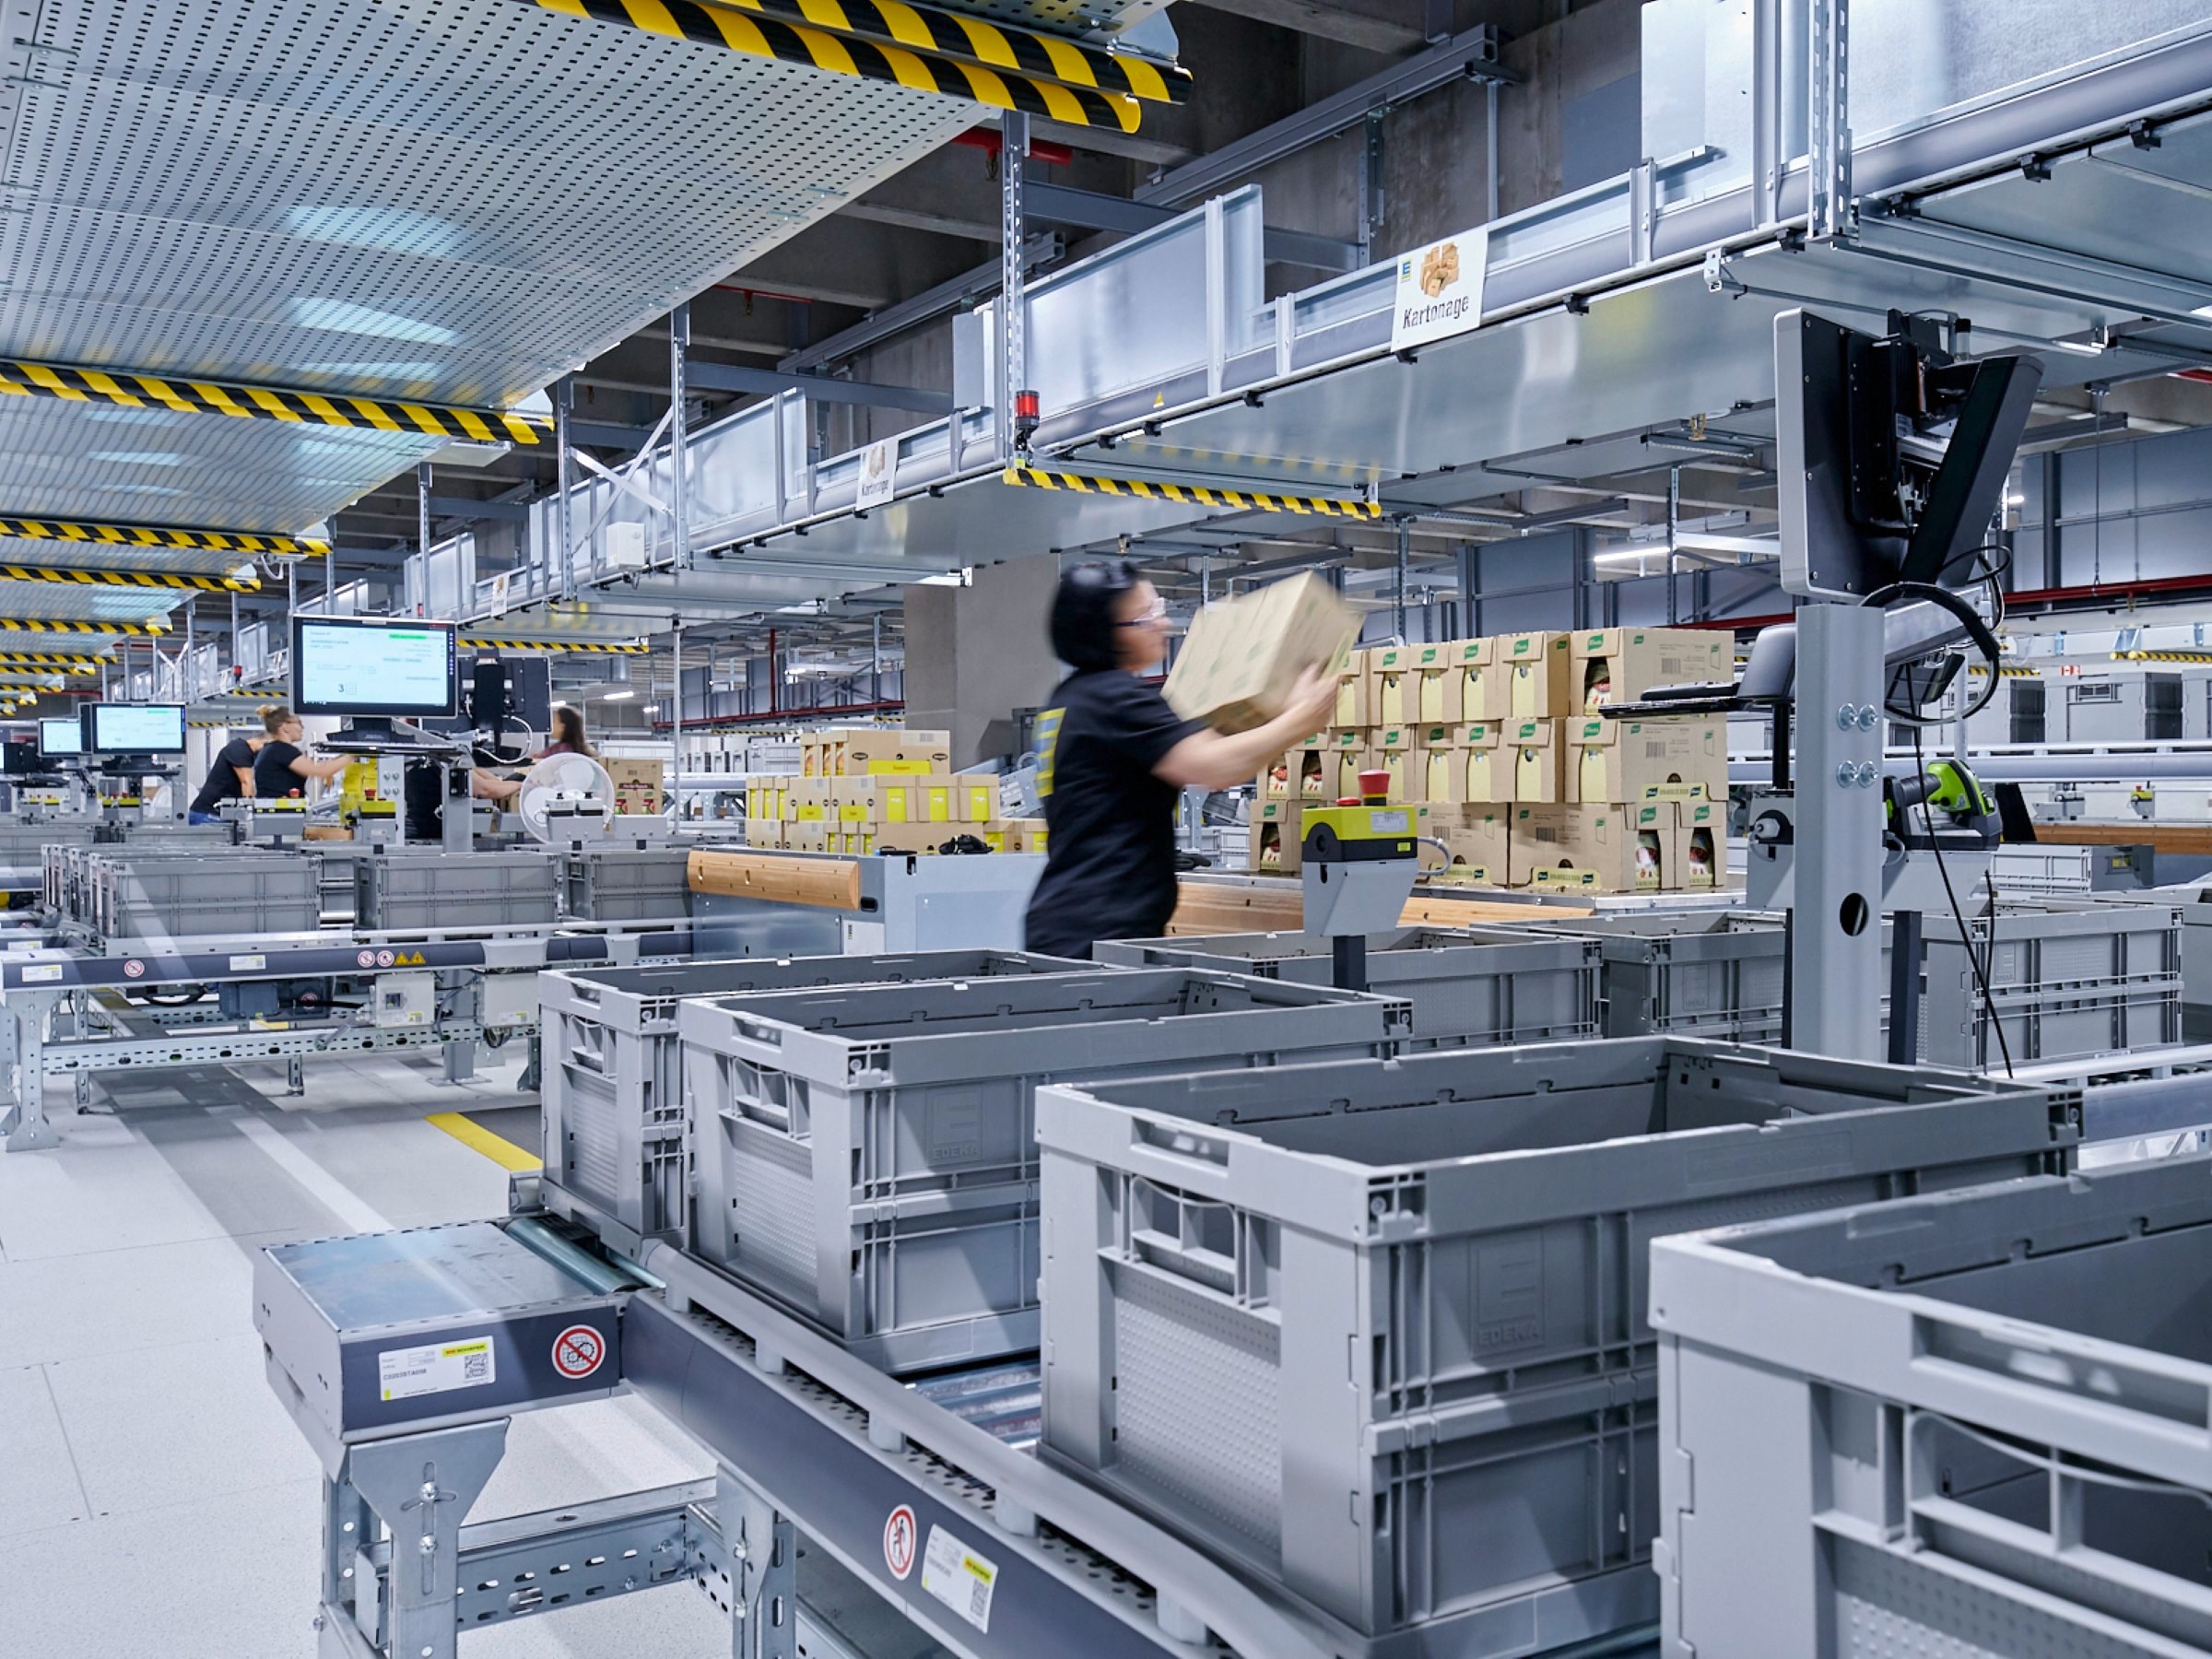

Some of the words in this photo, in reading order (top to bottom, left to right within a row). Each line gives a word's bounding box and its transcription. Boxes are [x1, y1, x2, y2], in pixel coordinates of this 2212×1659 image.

[1402, 295, 1470, 329] Kartonage
[932, 1145, 980, 1160] EDEKA
[1476, 1324, 1539, 1347] EDEKA
